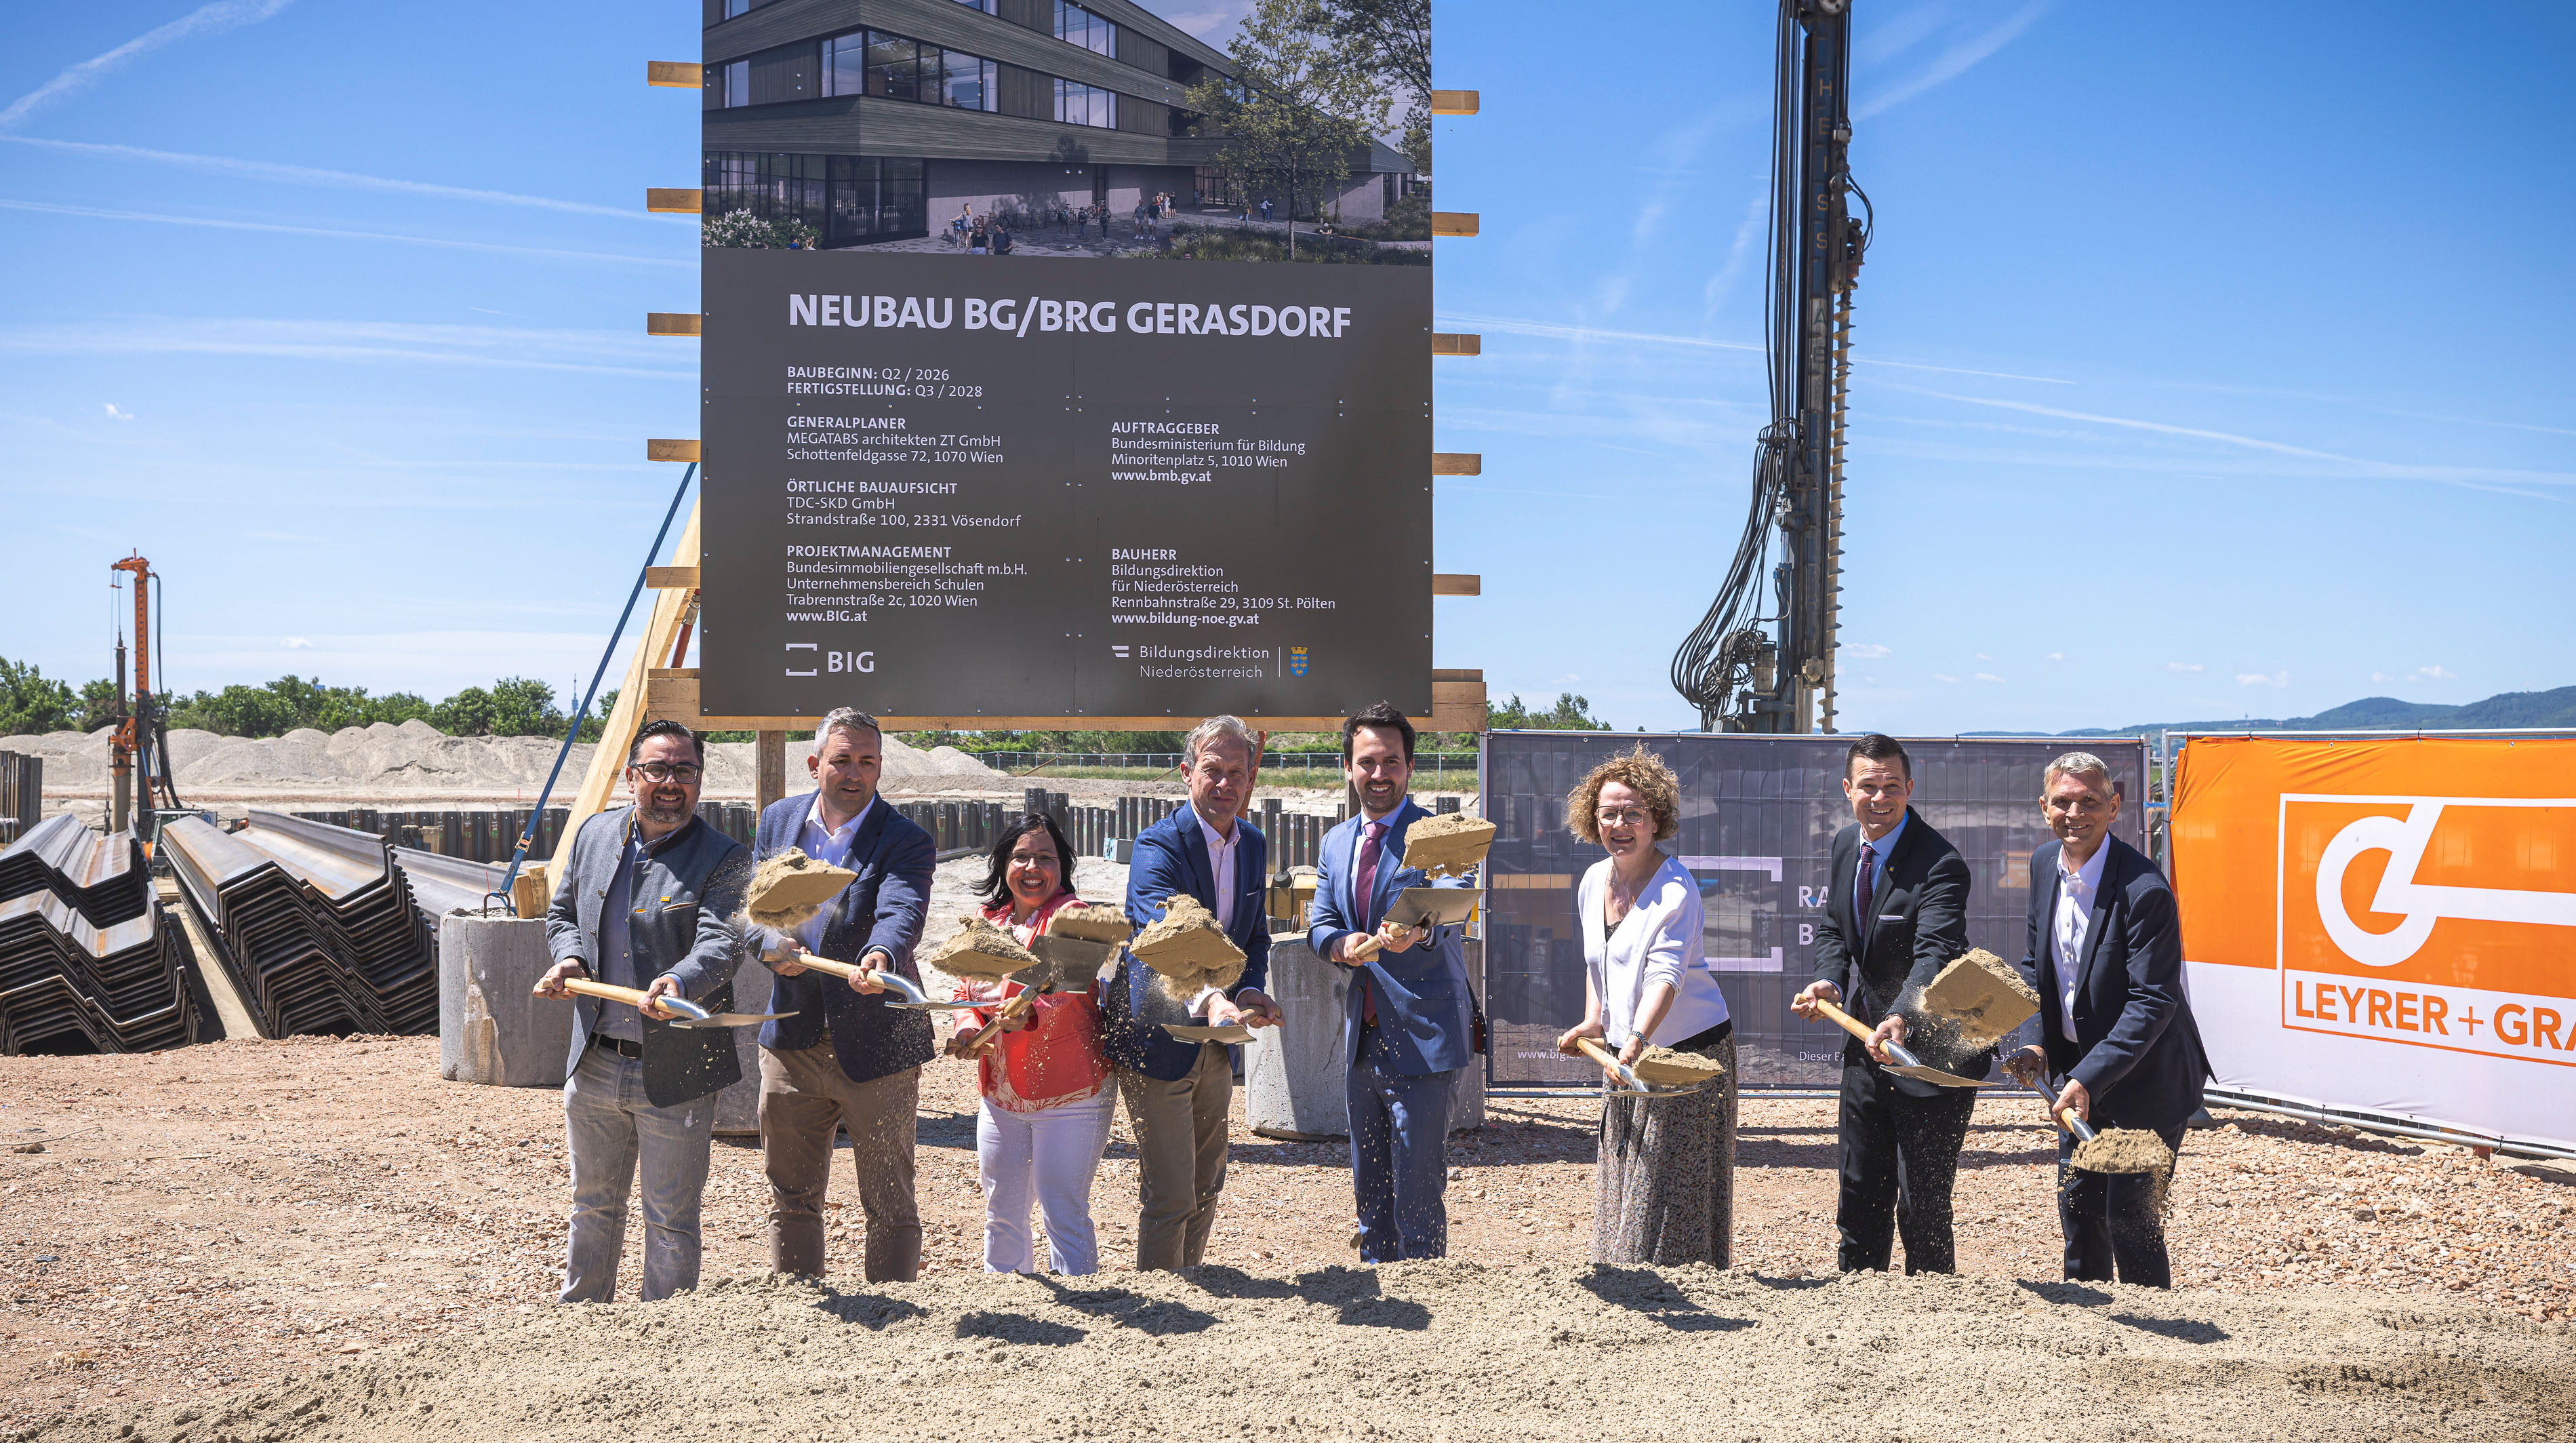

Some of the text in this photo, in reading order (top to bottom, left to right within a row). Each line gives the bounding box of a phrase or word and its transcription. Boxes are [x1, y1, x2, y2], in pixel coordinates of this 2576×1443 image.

[790, 294, 1350, 337] NEUBAU BG/BRG GERASDORF
[787, 365, 949, 382] BAUBEGINN: Q2 / 2026
[787, 382, 982, 398] FERTIGSTELLUNG: Q3 / 2028
[786, 416, 906, 429] GENERALPLANER
[1111, 422, 1219, 434] AUFTRAGGEBER
[786, 432, 1000, 446] MEGATABS architekten ZT GmbH
[1112, 437, 1305, 455] Bundesministerium für Bildung
[787, 448, 1003, 464] Schottenfeldgasse 72, 1070 Wien
[1111, 453, 1287, 469] Minoritenplatz 5, 1010 Wien
[1111, 469, 1211, 485] www.bmb.gv.at
[786, 477, 957, 494] ÖRTLICHE BAUAUFSICHT
[786, 496, 894, 509] TDC-SKD GmbH
[786, 512, 1021, 527] Strandstraße 100, 2331 Vösendorf
[787, 545, 951, 557] PROJEKTMANAGEMENT
[1112, 548, 1177, 560] BAUHERR
[787, 561, 1027, 577] Bundesimmobiliengesellschaft m.b.H.
[1112, 564, 1223, 579] Bildungsdirektion
[787, 577, 984, 590] Unternehmensbereich Schulen
[1111, 579, 1238, 592] für Niederösterreich
[786, 593, 977, 608] Trabrennstraße 2c, 1020 Wien
[1112, 595, 1335, 610] Rennbahnstraße 29, 3109 St. Pölten
[786, 610, 867, 621] www.BIG.at
[1111, 611, 1259, 627] www.bildung-noe.gv.at
[1140, 645, 1268, 661] Bildungsdirektion
[828, 651, 874, 673] BIG
[1140, 664, 1262, 677] Niederösterreich
[1798, 924, 1821, 945] B
[2296, 981, 2449, 1036] LEYRER
[2458, 1006, 2484, 1036] +
[1517, 1048, 1581, 1062] www.big.
[1799, 1051, 1832, 1061] Dieser
